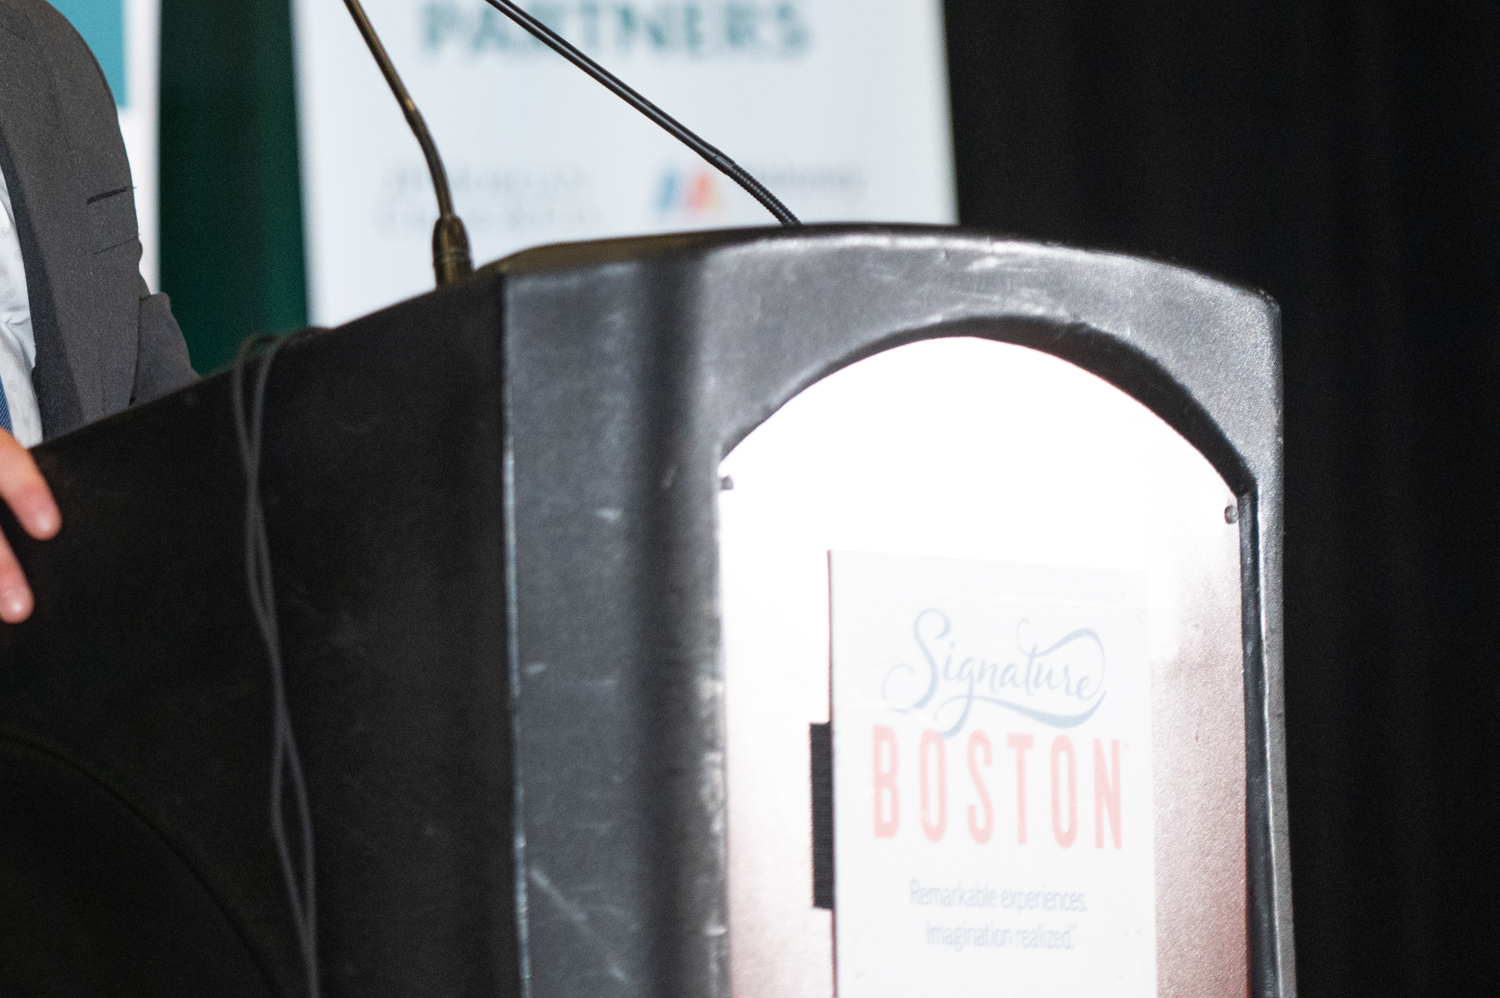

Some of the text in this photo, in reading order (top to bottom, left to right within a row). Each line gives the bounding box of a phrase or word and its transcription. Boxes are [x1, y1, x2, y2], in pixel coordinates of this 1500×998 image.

[883, 608, 1107, 738] Signature
[872, 724, 1123, 850] BOSTON
[908, 878, 1089, 915] Remarkable experiences.
[925, 919, 1013, 953] Imagination
